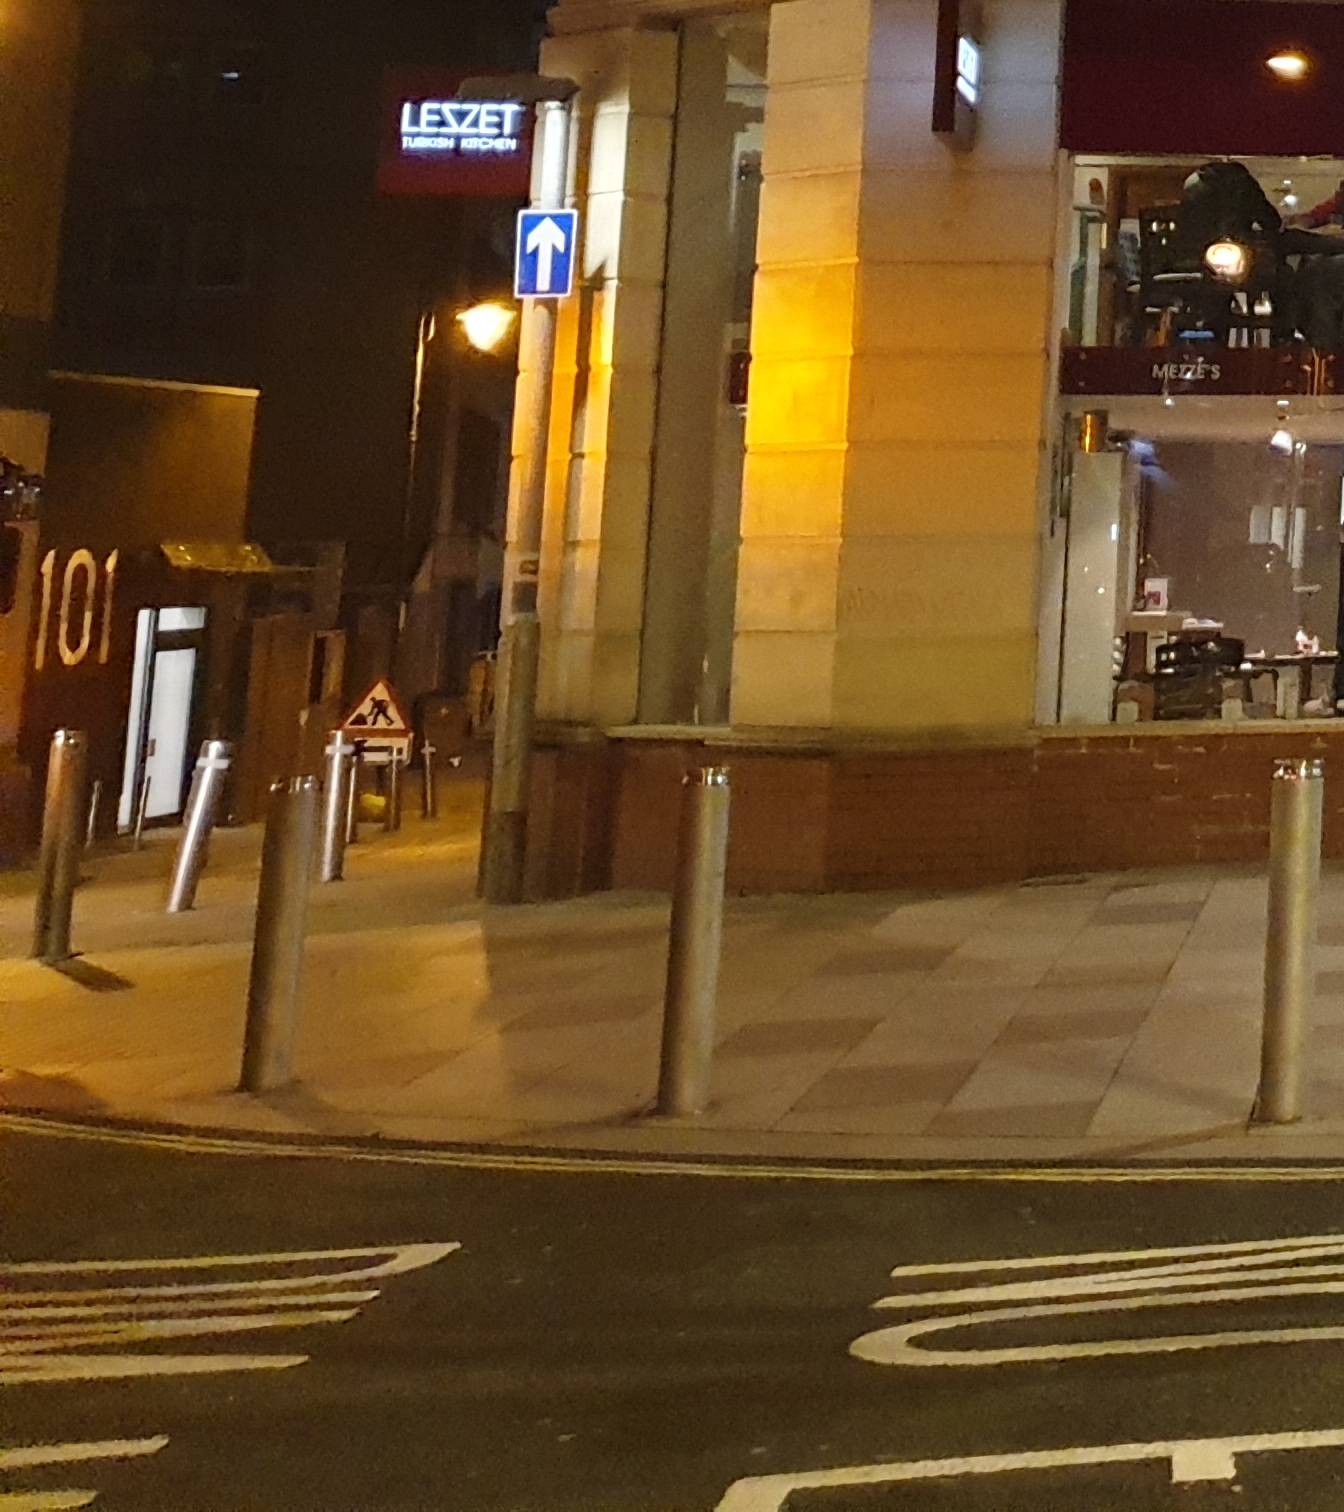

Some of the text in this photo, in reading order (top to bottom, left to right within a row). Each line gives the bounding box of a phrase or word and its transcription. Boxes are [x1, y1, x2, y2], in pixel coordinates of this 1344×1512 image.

[402, 137, 518, 151] TURKISH KITCHEN
[35, 548, 118, 671] 101
